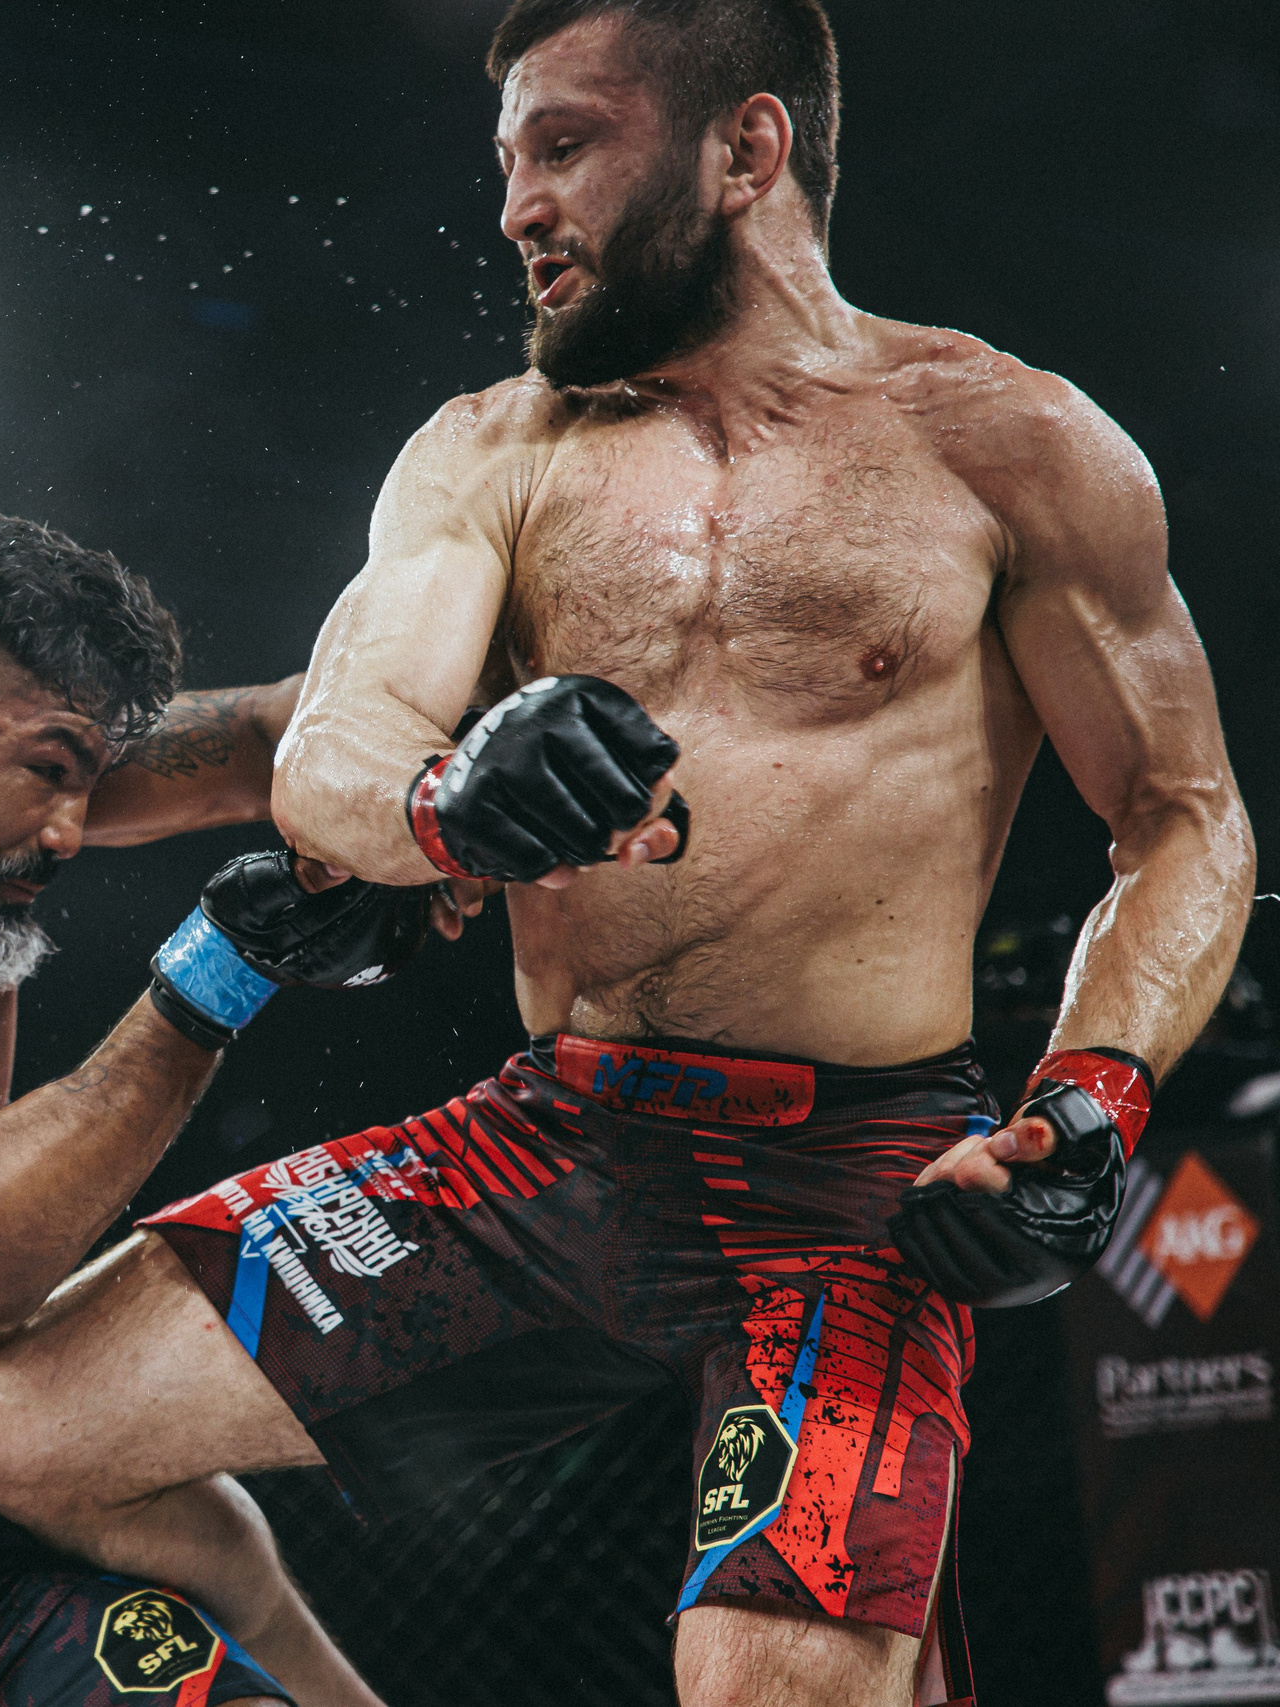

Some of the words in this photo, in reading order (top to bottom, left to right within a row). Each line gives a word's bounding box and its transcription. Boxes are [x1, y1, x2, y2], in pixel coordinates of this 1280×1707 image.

[593, 1053, 728, 1107] MFP
[210, 1179, 254, 1216] ОТА
[241, 1208, 276, 1243] НА
[261, 1234, 345, 1335] ХИЩНИКА
[703, 1484, 749, 1515] SFL
[138, 1635, 198, 1675] SFL
